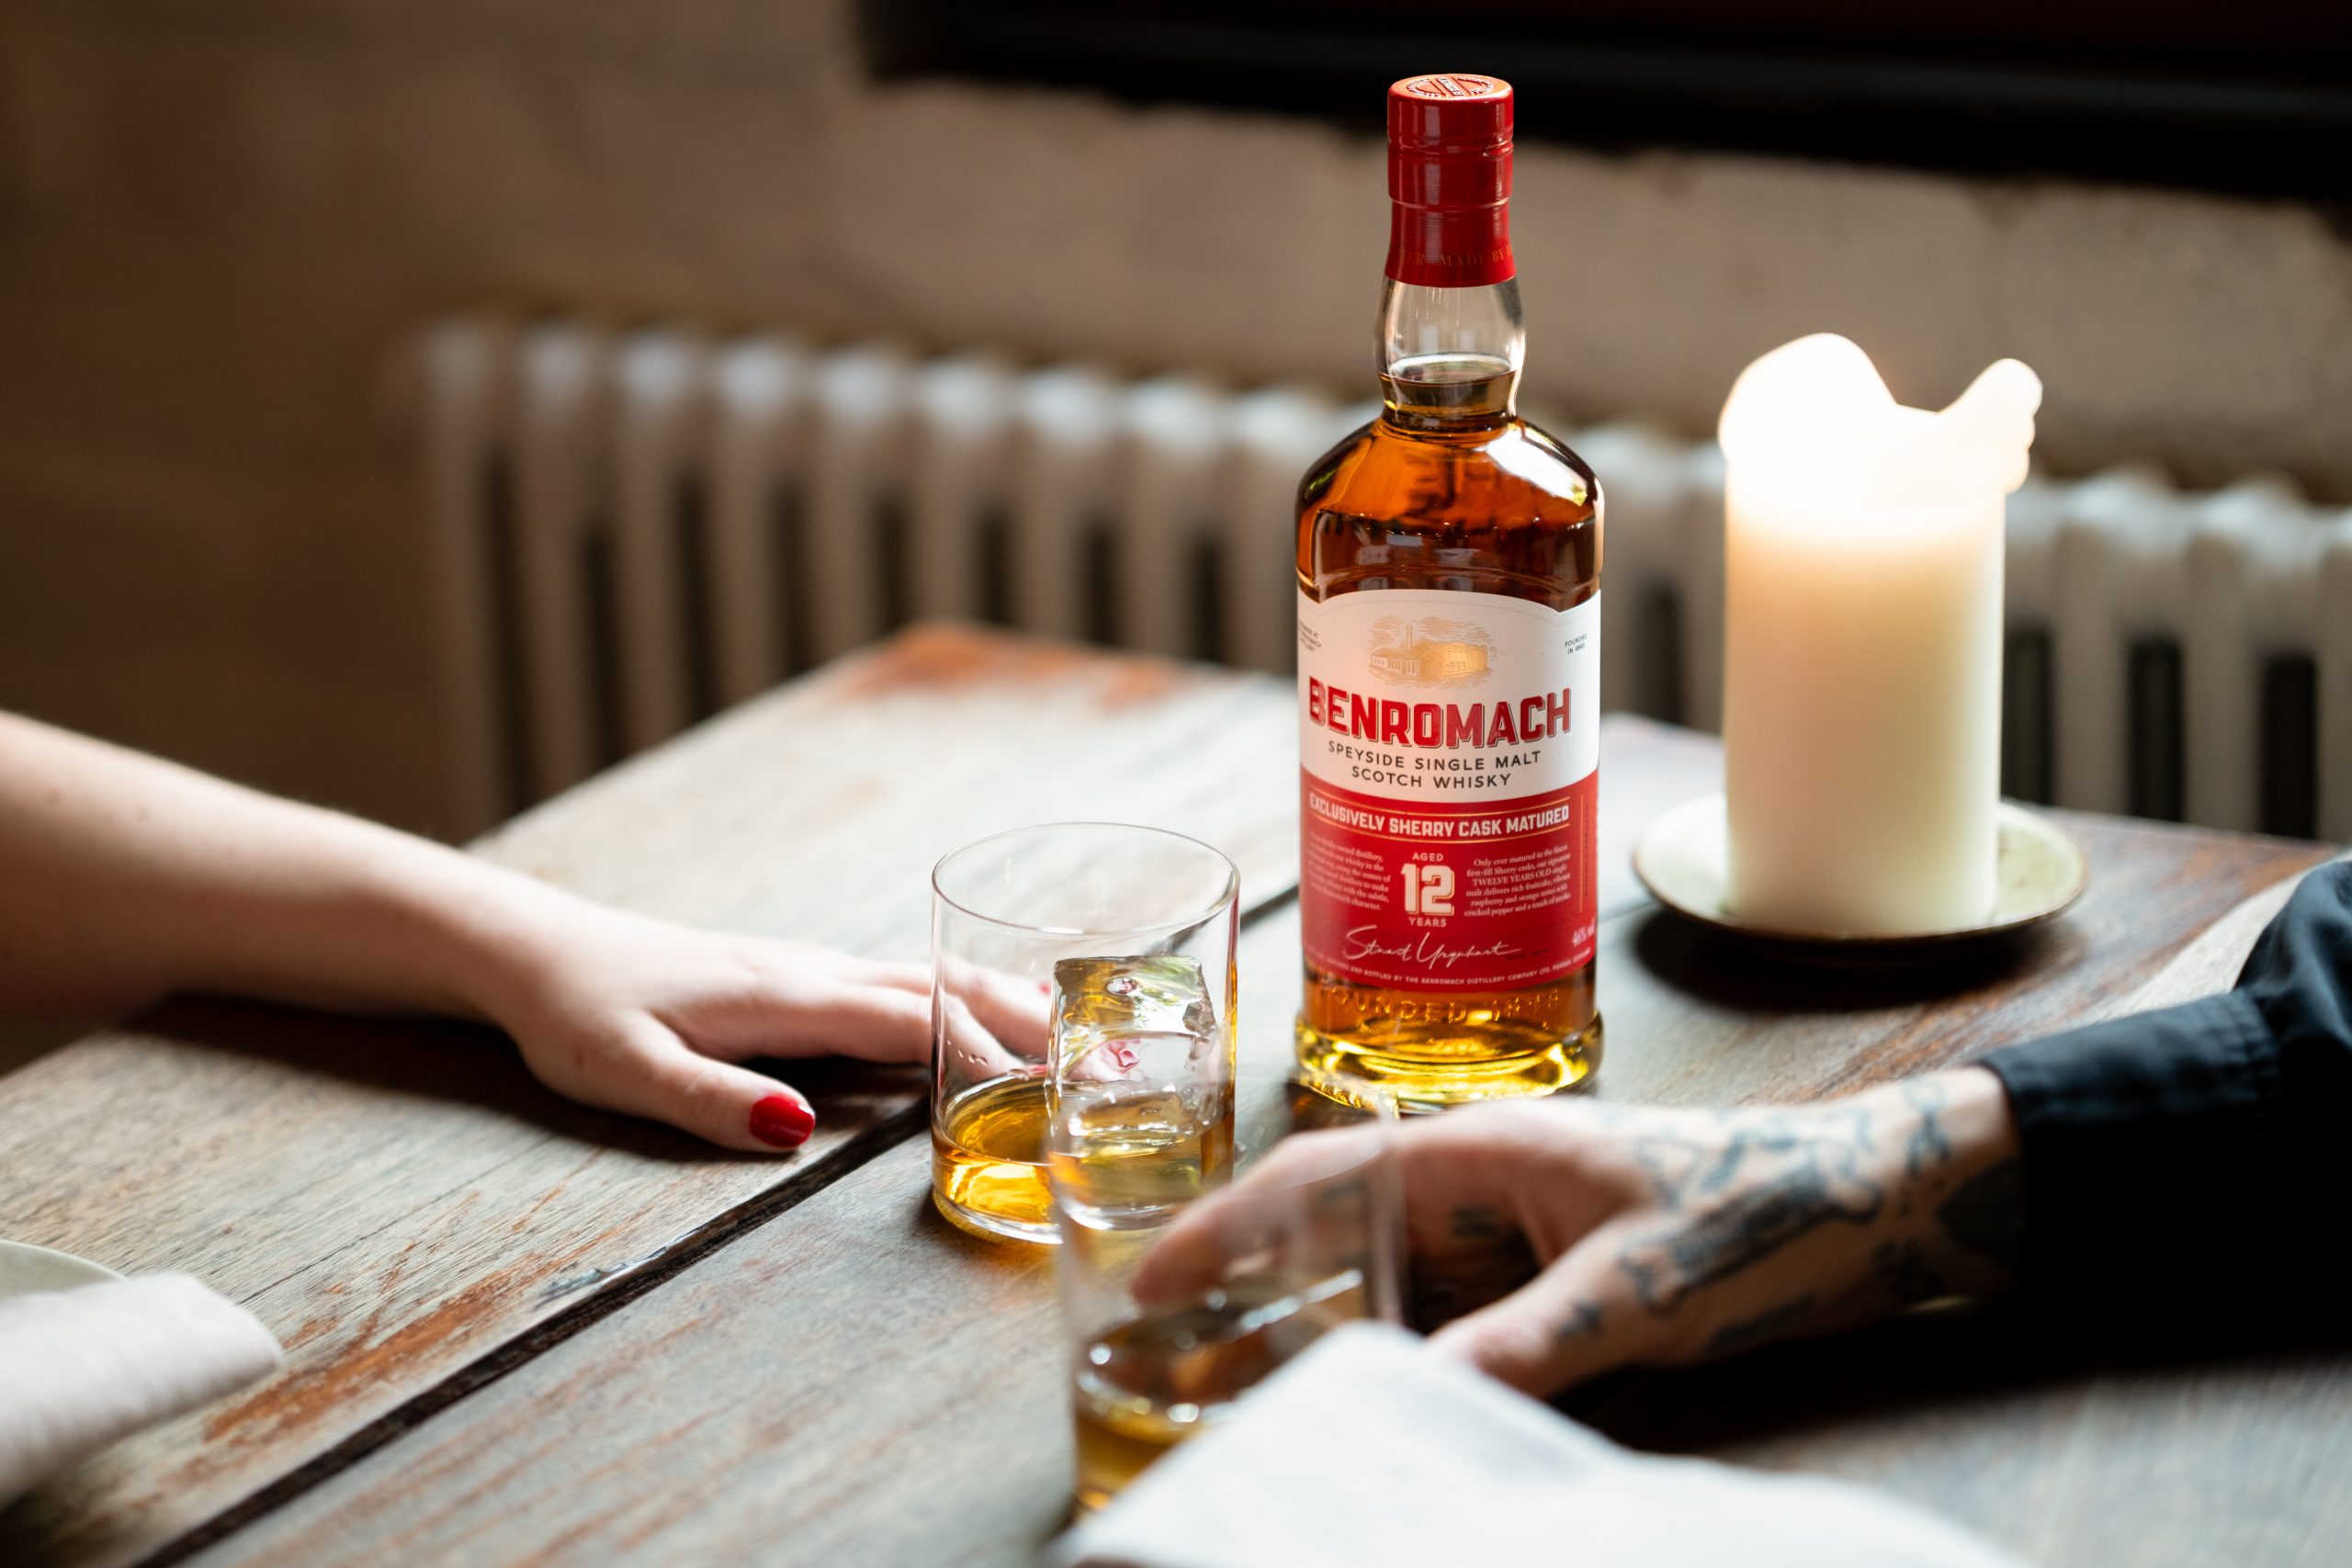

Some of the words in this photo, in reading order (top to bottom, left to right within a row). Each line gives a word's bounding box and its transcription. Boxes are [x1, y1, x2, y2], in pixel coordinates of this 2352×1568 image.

[1309, 675, 1571, 750] BENROMACH
[1329, 740, 1405, 769] SPEYSIDE
[1414, 757, 1485, 772] SINGLE
[1495, 750, 1542, 770] MALT
[1351, 765, 1422, 788] SCOTCH
[1432, 773, 1511, 789] WHISKY
[1308, 792, 1385, 831] EXCLUSIVELY
[1388, 818, 1454, 838] SHERRY
[1458, 818, 1502, 838] CASK
[1506, 804, 1569, 834] MATURED
[1412, 852, 1444, 863] AGED
[1474, 858, 1492, 868] Only
[1493, 858, 1508, 866] ever
[1510, 852, 1536, 863] matured
[1536, 850, 1544, 858] in
[1544, 848, 1553, 857] the
[1374, 863, 1385, 872] the
[1466, 868, 1493, 877] first-fill
[1494, 866, 1518, 876] Sherry
[1383, 874, 1391, 883] of
[1472, 876, 1510, 886] TWELVE
[1510, 872, 1535, 884] YEARS
[1535, 868, 1552, 879] OLD
[1401, 863, 1455, 916] 12
[1466, 888, 1483, 897] malt
[1484, 886, 1510, 896] delivers
[1511, 884, 1524, 893] rich
[1471, 898, 1503, 908] raspberry
[1505, 895, 1518, 904] and
[1464, 908, 1490, 918] cracked
[1491, 907, 1515, 918] pepper
[1514, 903, 1527, 912] and
[1408, 917, 1448, 928] YEARS
[1363, 969, 1393, 980] BOTTLED
[1405, 976, 1419, 984] THE
[1421, 976, 1465, 986] BENROMACH
[1467, 975, 1506, 985] DISTILLERY
[1507, 969, 1538, 981] COMPANY
